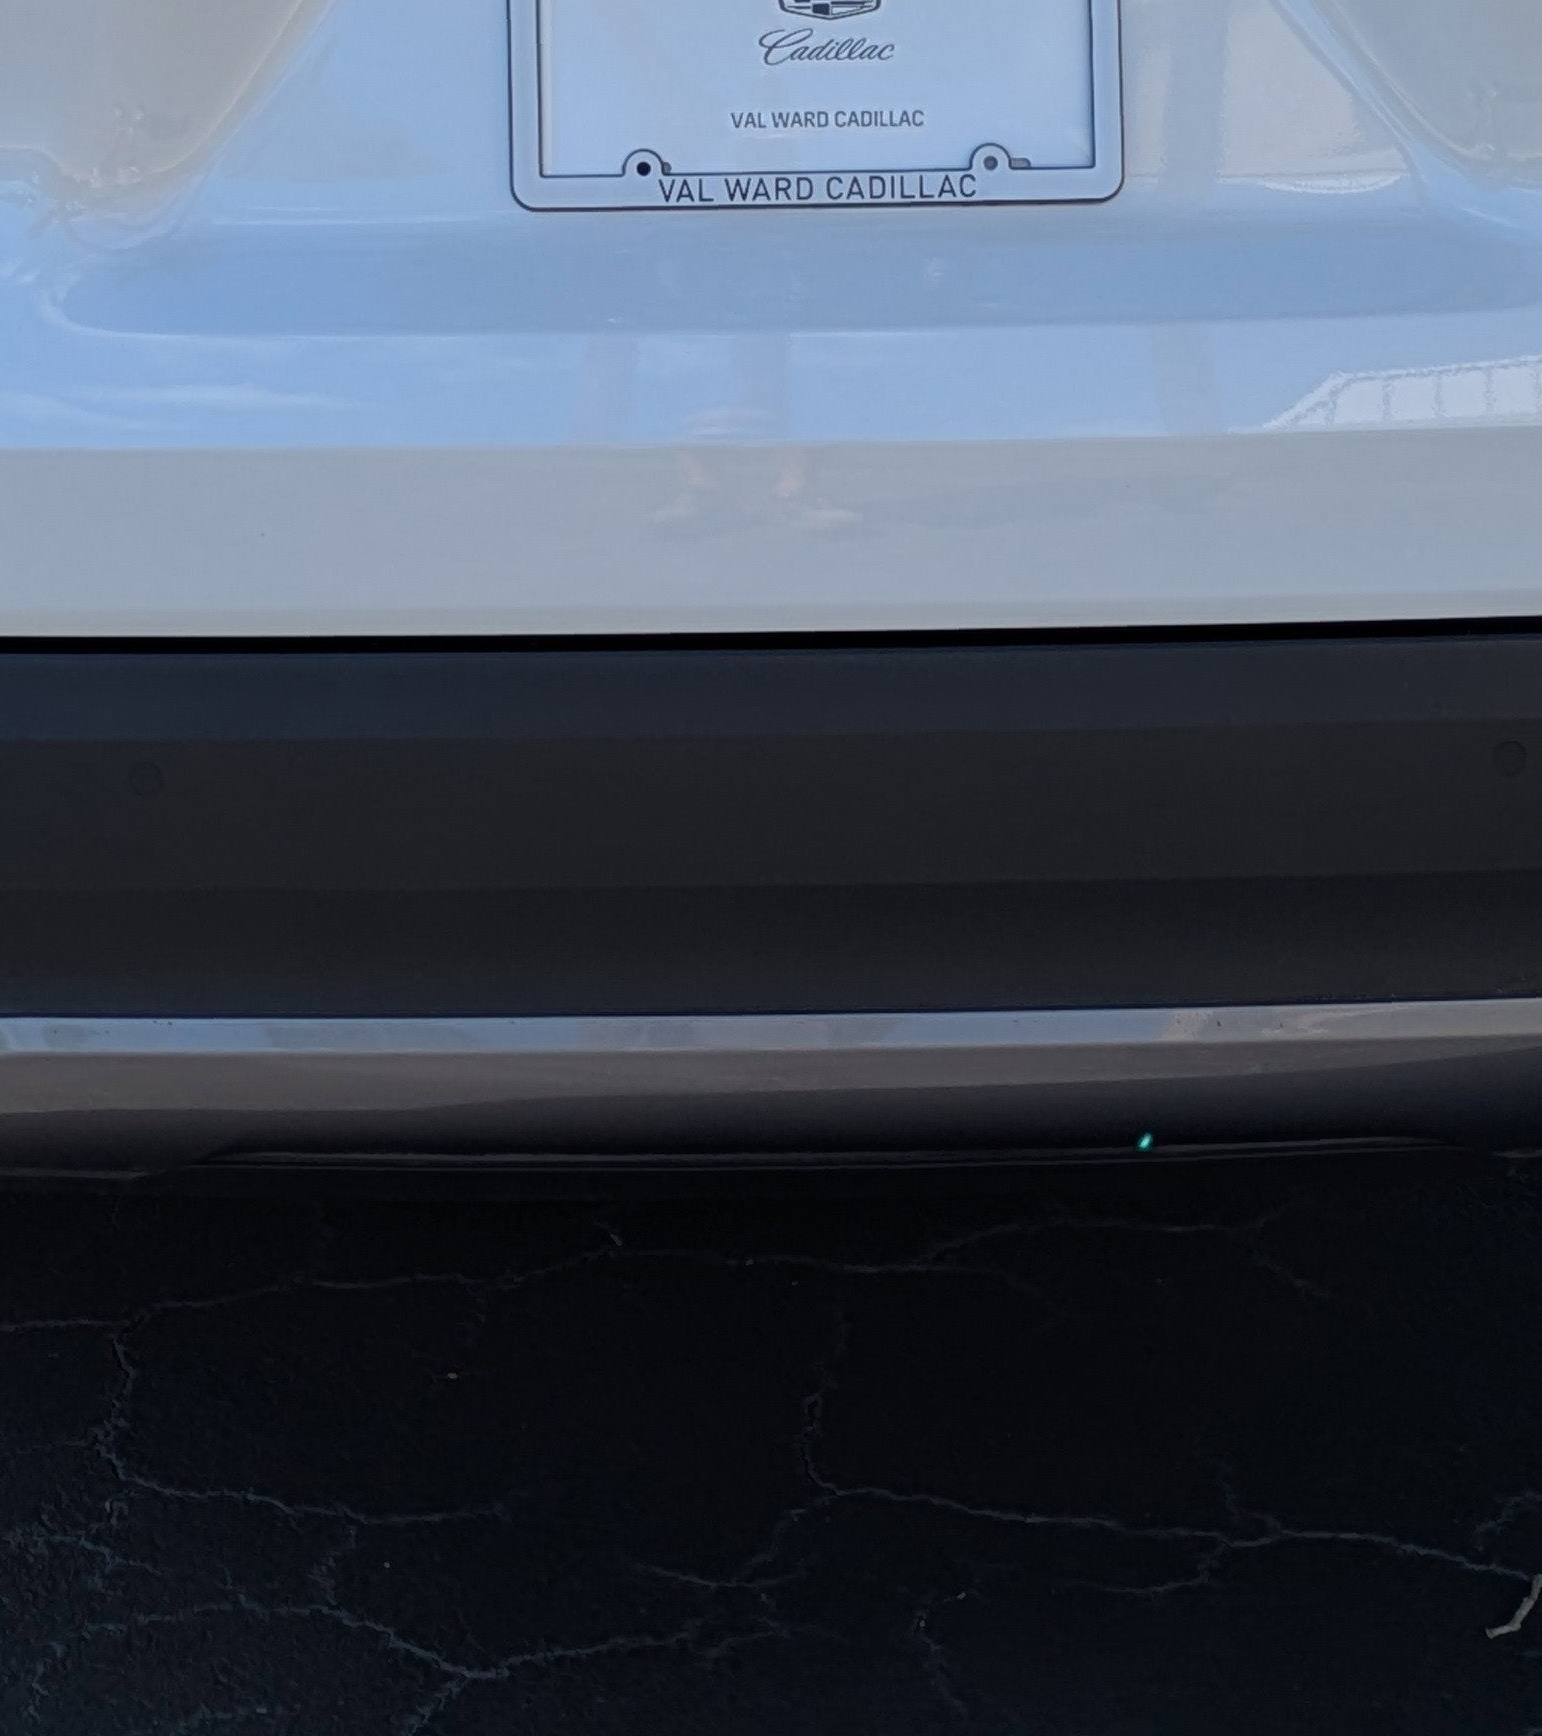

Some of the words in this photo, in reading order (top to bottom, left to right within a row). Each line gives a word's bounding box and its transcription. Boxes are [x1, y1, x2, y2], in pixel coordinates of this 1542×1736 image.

[758, 28, 896, 66] Cadillac
[730, 112, 765, 129] VAL
[770, 111, 829, 129] WARD
[833, 110, 925, 127] CADILLAC
[658, 178, 714, 203] VAL
[723, 176, 814, 202] WARD
[825, 173, 977, 200] CADILLAC
